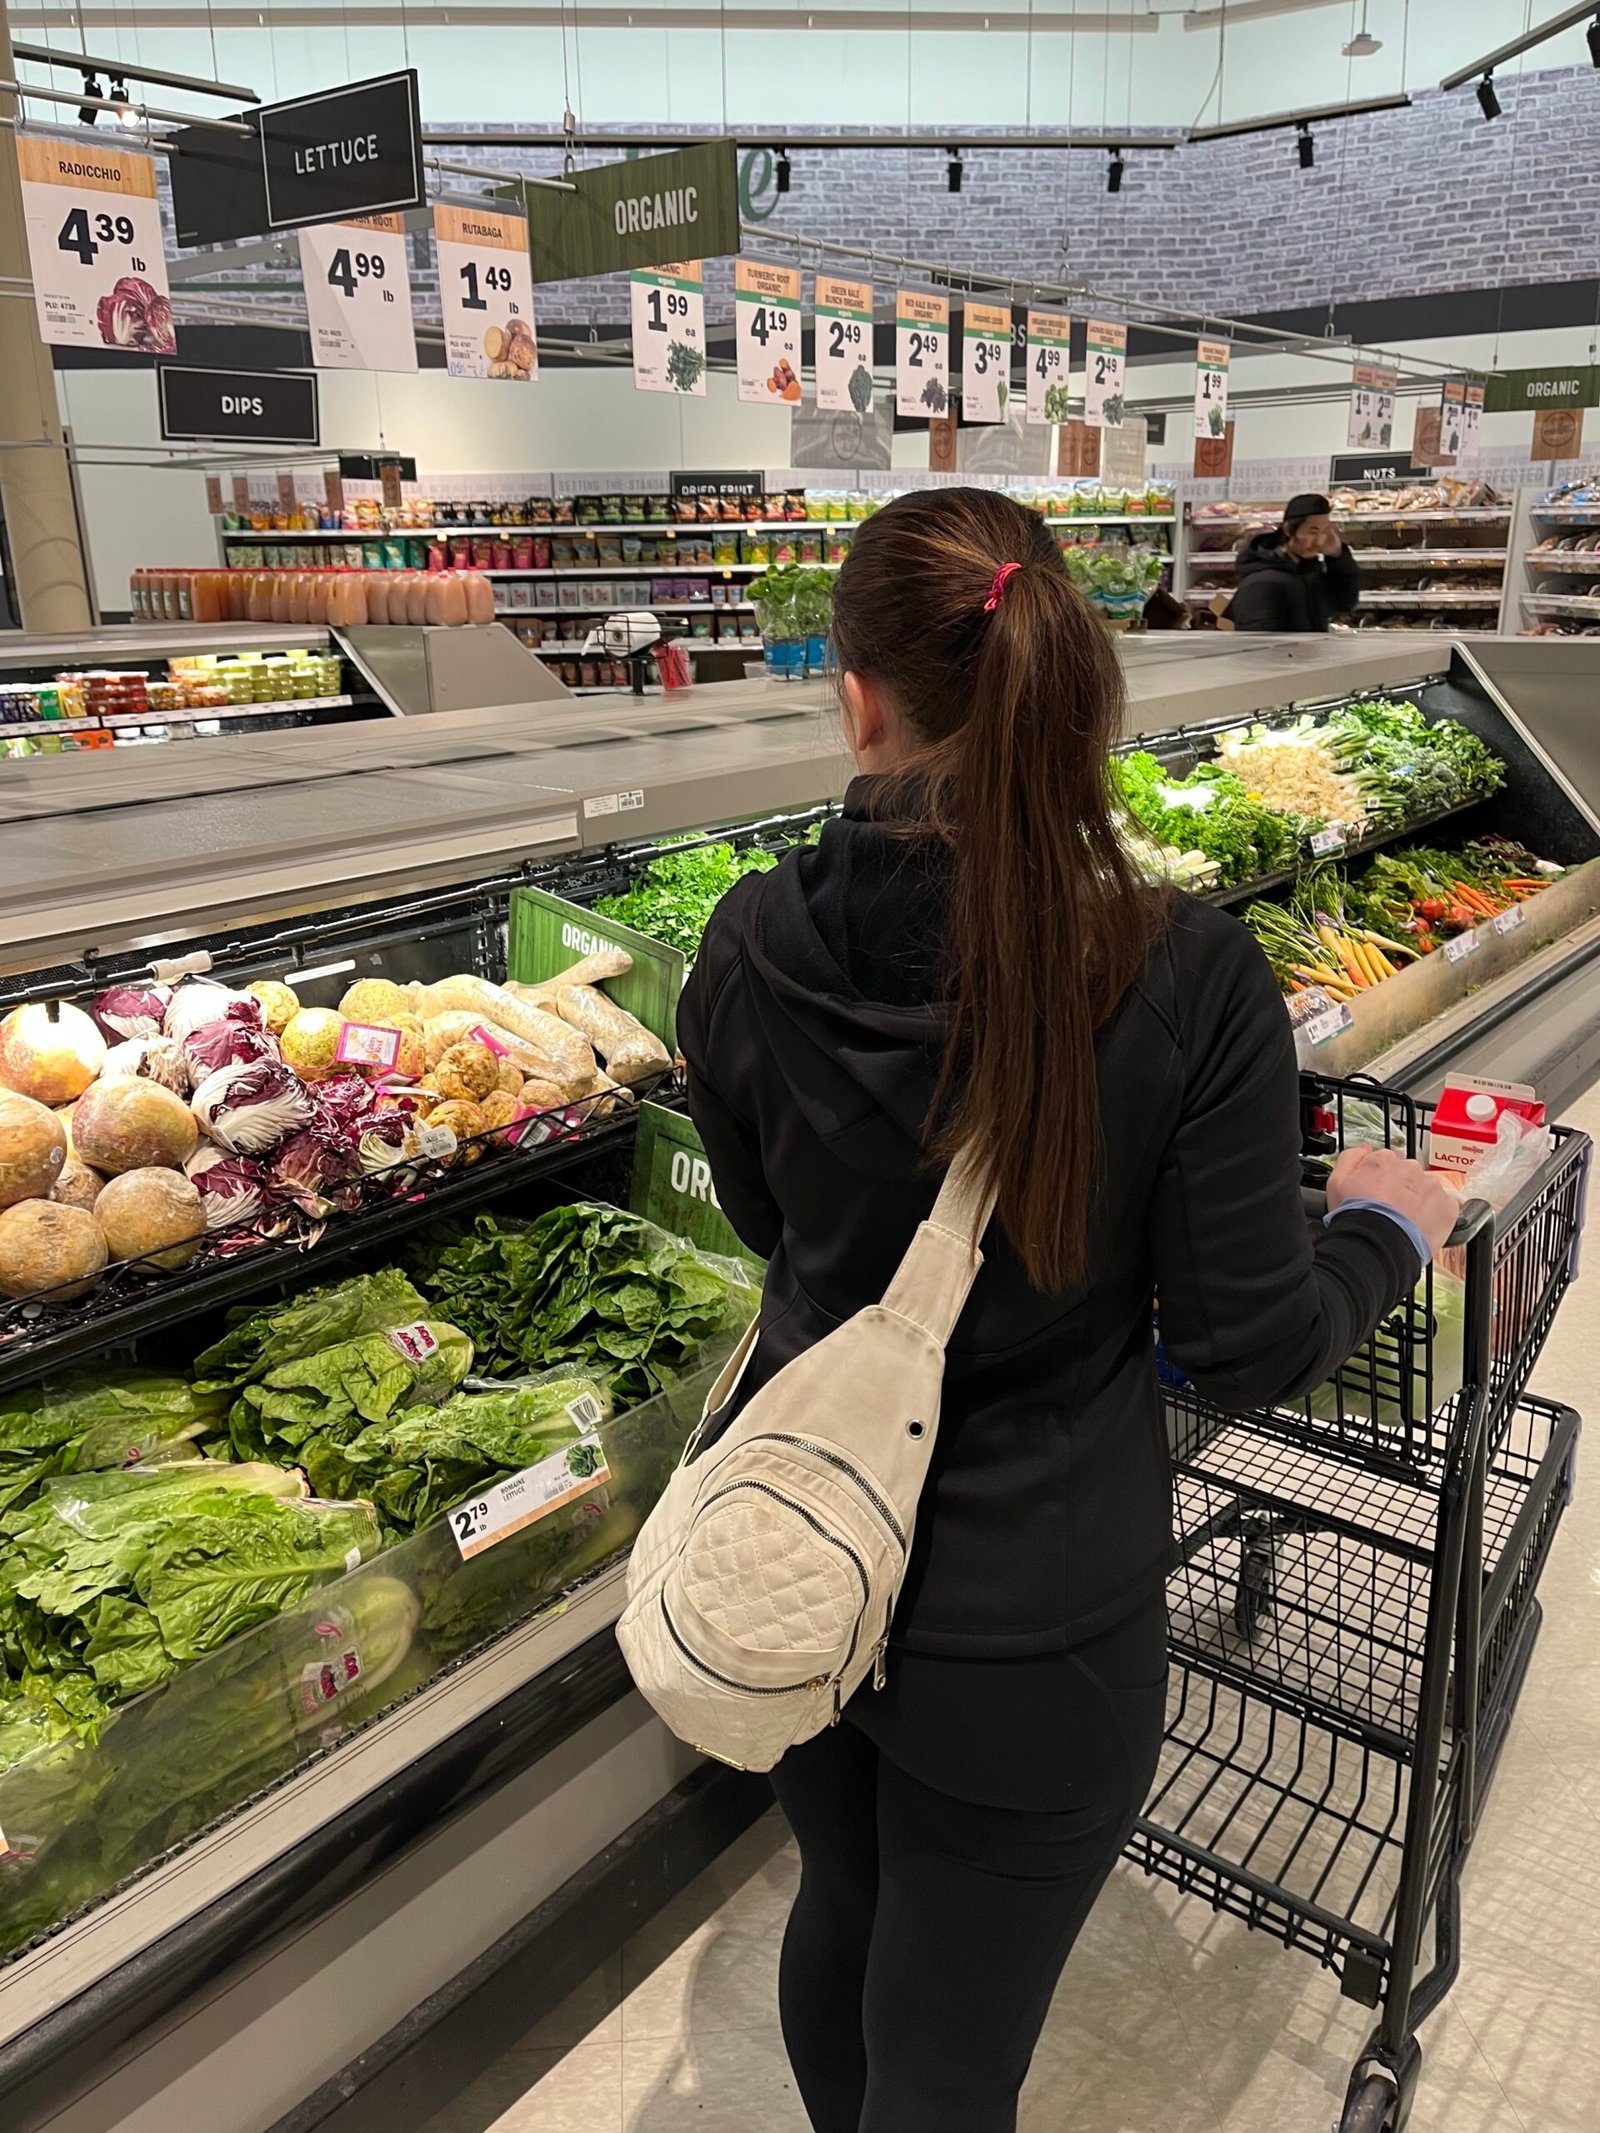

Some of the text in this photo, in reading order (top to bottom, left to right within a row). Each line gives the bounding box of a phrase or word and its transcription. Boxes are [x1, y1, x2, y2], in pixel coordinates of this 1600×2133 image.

[295, 134, 378, 175] LETTUCE
[59, 161, 121, 182] RADICCHIO
[614, 186, 698, 235] ORGANIC
[462, 222, 502, 239] RUTABAGA
[132, 258, 146, 271] lb
[747, 268, 790, 284] TURMERIC ROOT
[757, 281, 781, 293] ORGANIC
[831, 286, 859, 298] GREEN KALE
[383, 290, 394, 302] lb
[825, 294, 842, 305] BUNCH
[905, 298, 914, 307] RED
[509, 302, 519, 314] lb
[685, 327, 696, 337] ea
[784, 342, 793, 350] ea
[1526, 379, 1580, 397] ORGANIC
[221, 395, 263, 415] DIPS
[1363, 467, 1396, 480] NUTS
[500, 1477, 526, 1494] ROMAINE
[503, 1485, 526, 1502] LETTUCE
